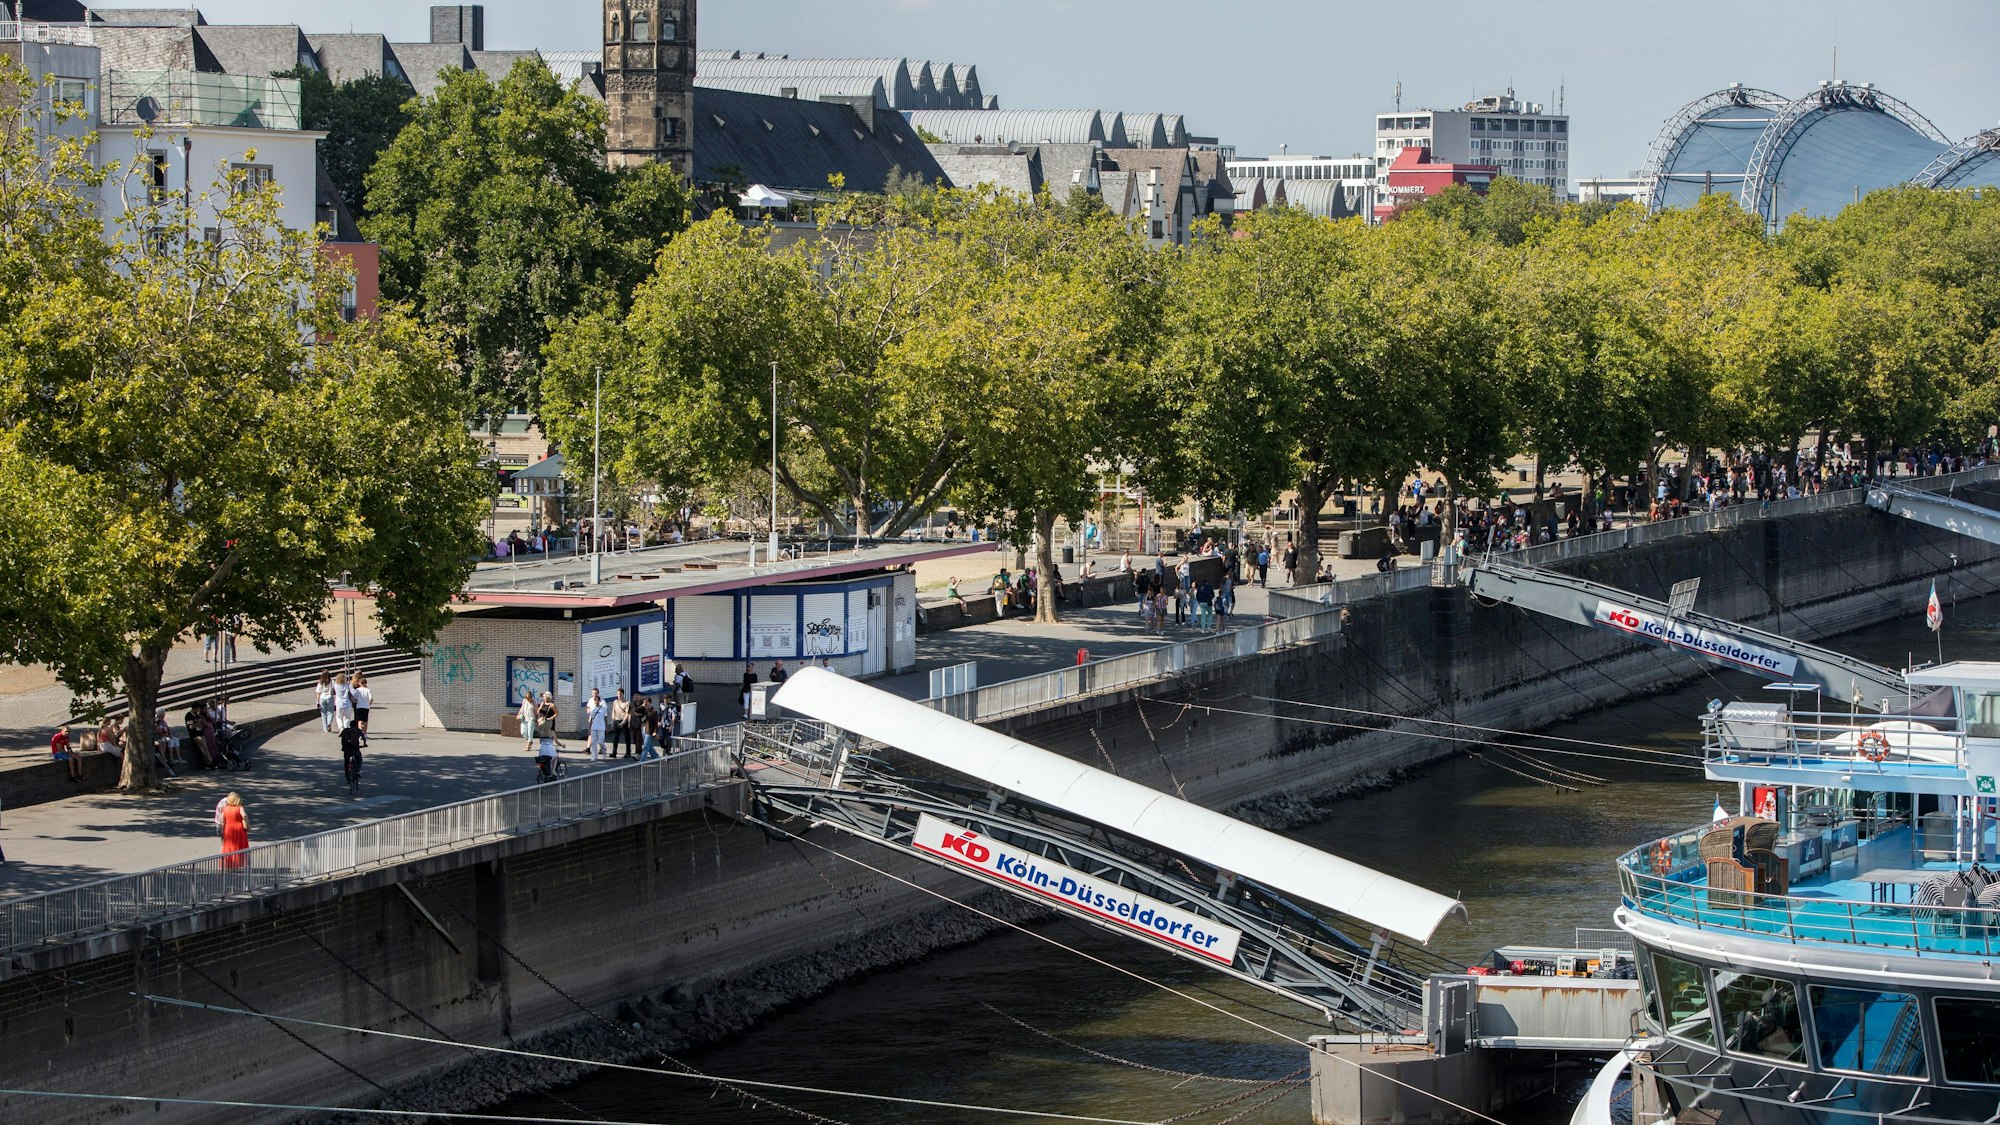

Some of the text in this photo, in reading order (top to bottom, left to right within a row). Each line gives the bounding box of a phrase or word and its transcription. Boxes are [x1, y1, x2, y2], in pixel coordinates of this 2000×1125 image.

[1609, 611, 1781, 669] KD Kön-Düsseldorfer
[941, 832, 1219, 948] KD Köln-Düsseldorfer
